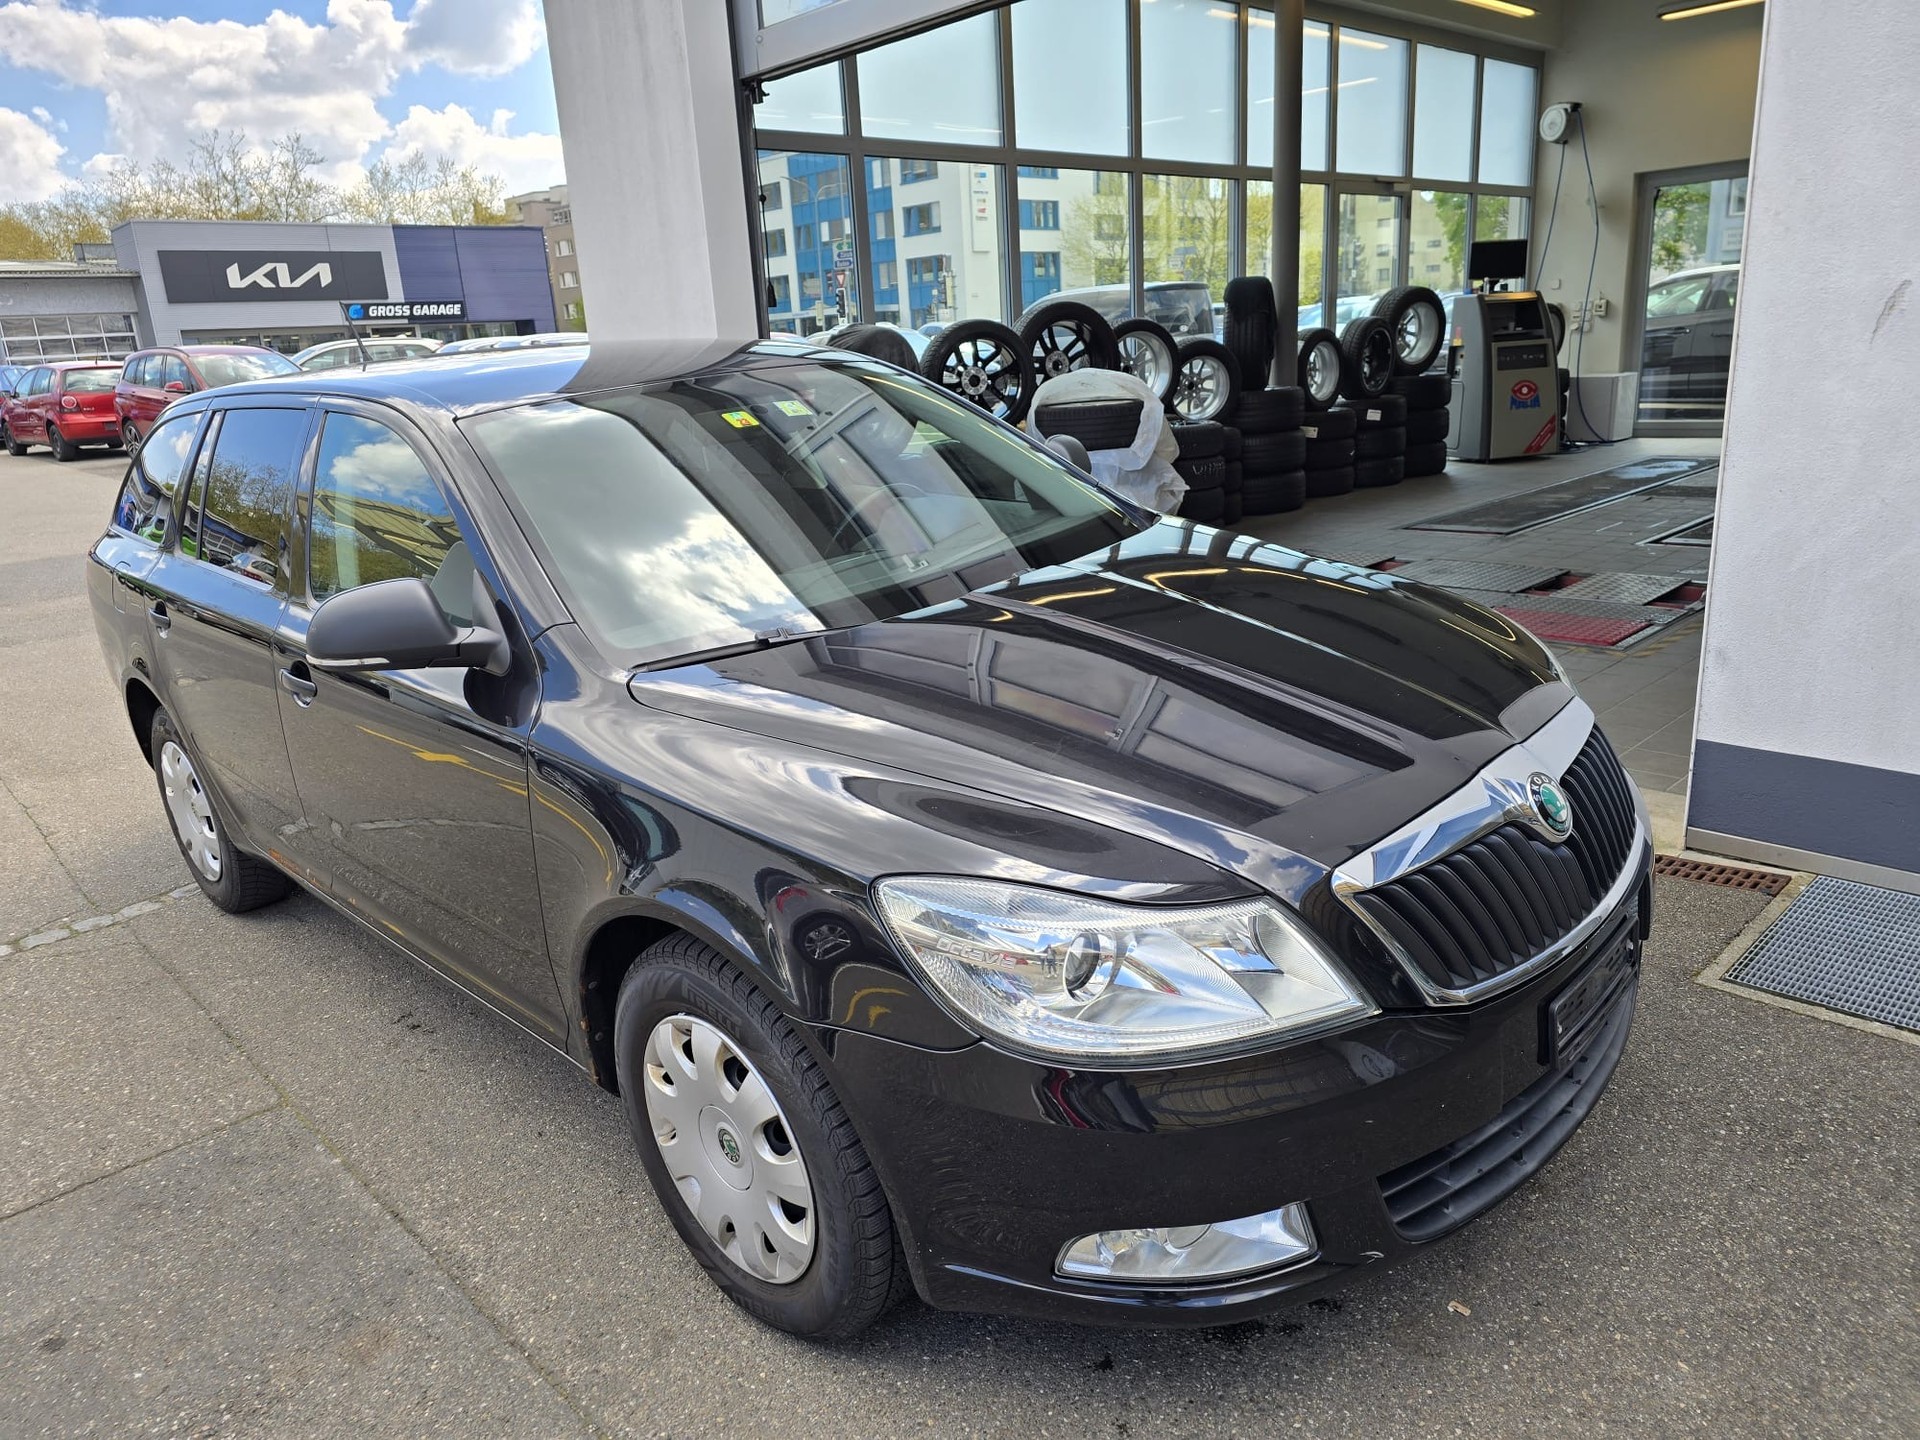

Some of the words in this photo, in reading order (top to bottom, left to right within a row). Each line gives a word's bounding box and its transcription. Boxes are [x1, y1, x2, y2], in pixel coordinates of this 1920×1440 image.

[226, 262, 333, 289] KIA
[368, 304, 411, 317] GROSS
[412, 304, 462, 316] GARAGE
[936, 937, 1017, 969] octavia
